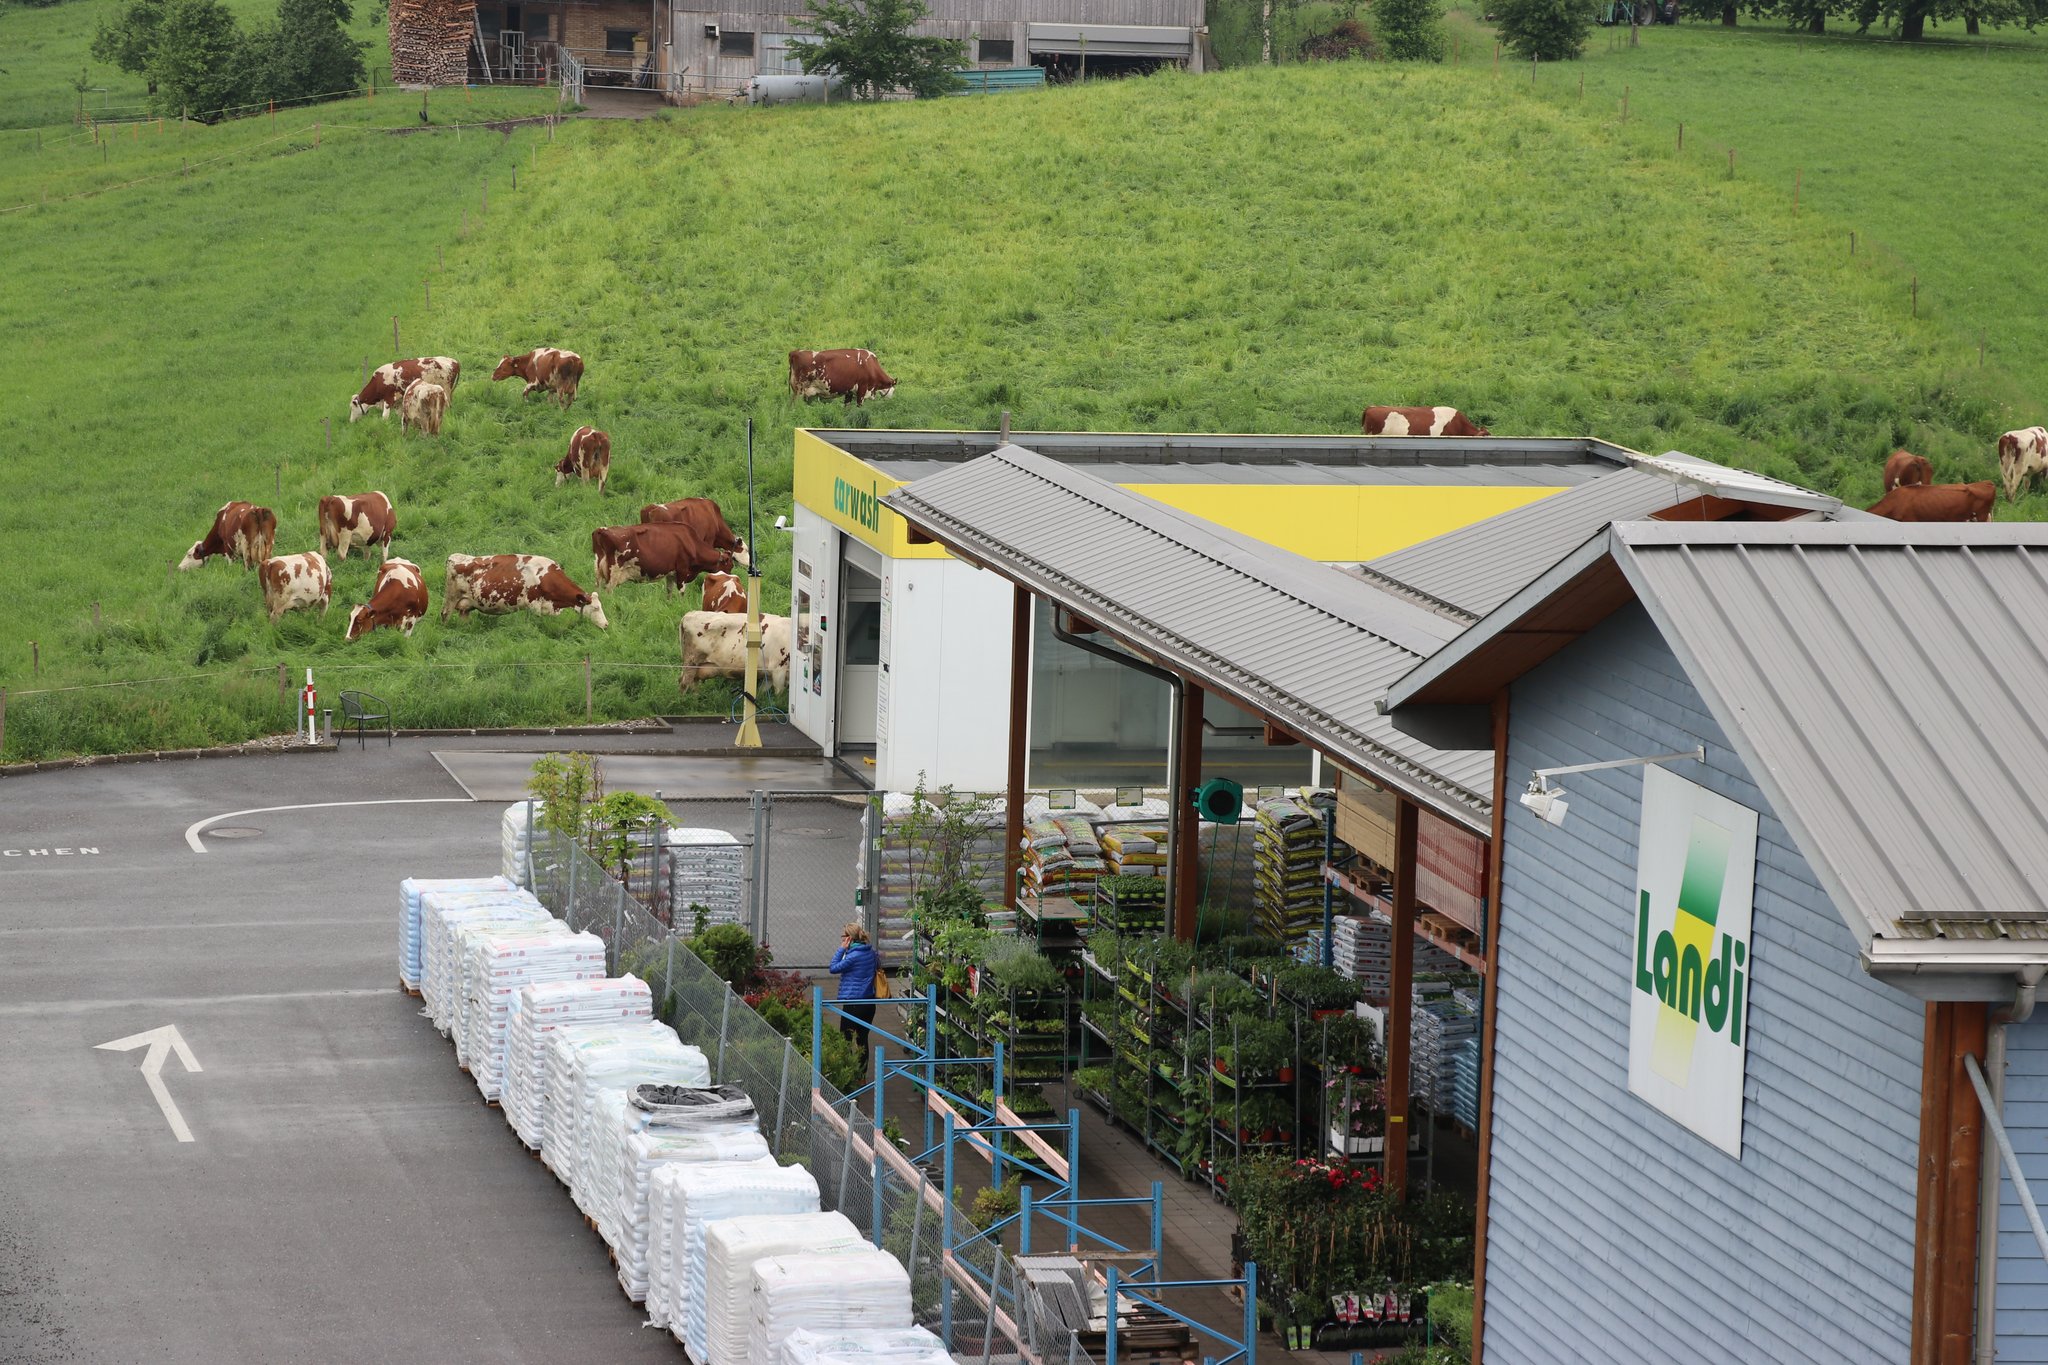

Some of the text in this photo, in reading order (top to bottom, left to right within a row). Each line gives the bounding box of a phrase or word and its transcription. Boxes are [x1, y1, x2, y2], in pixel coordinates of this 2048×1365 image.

[834, 476, 879, 533] carwash
[3, 847, 100, 857] CHEN
[1636, 889, 1745, 1046] Landi
